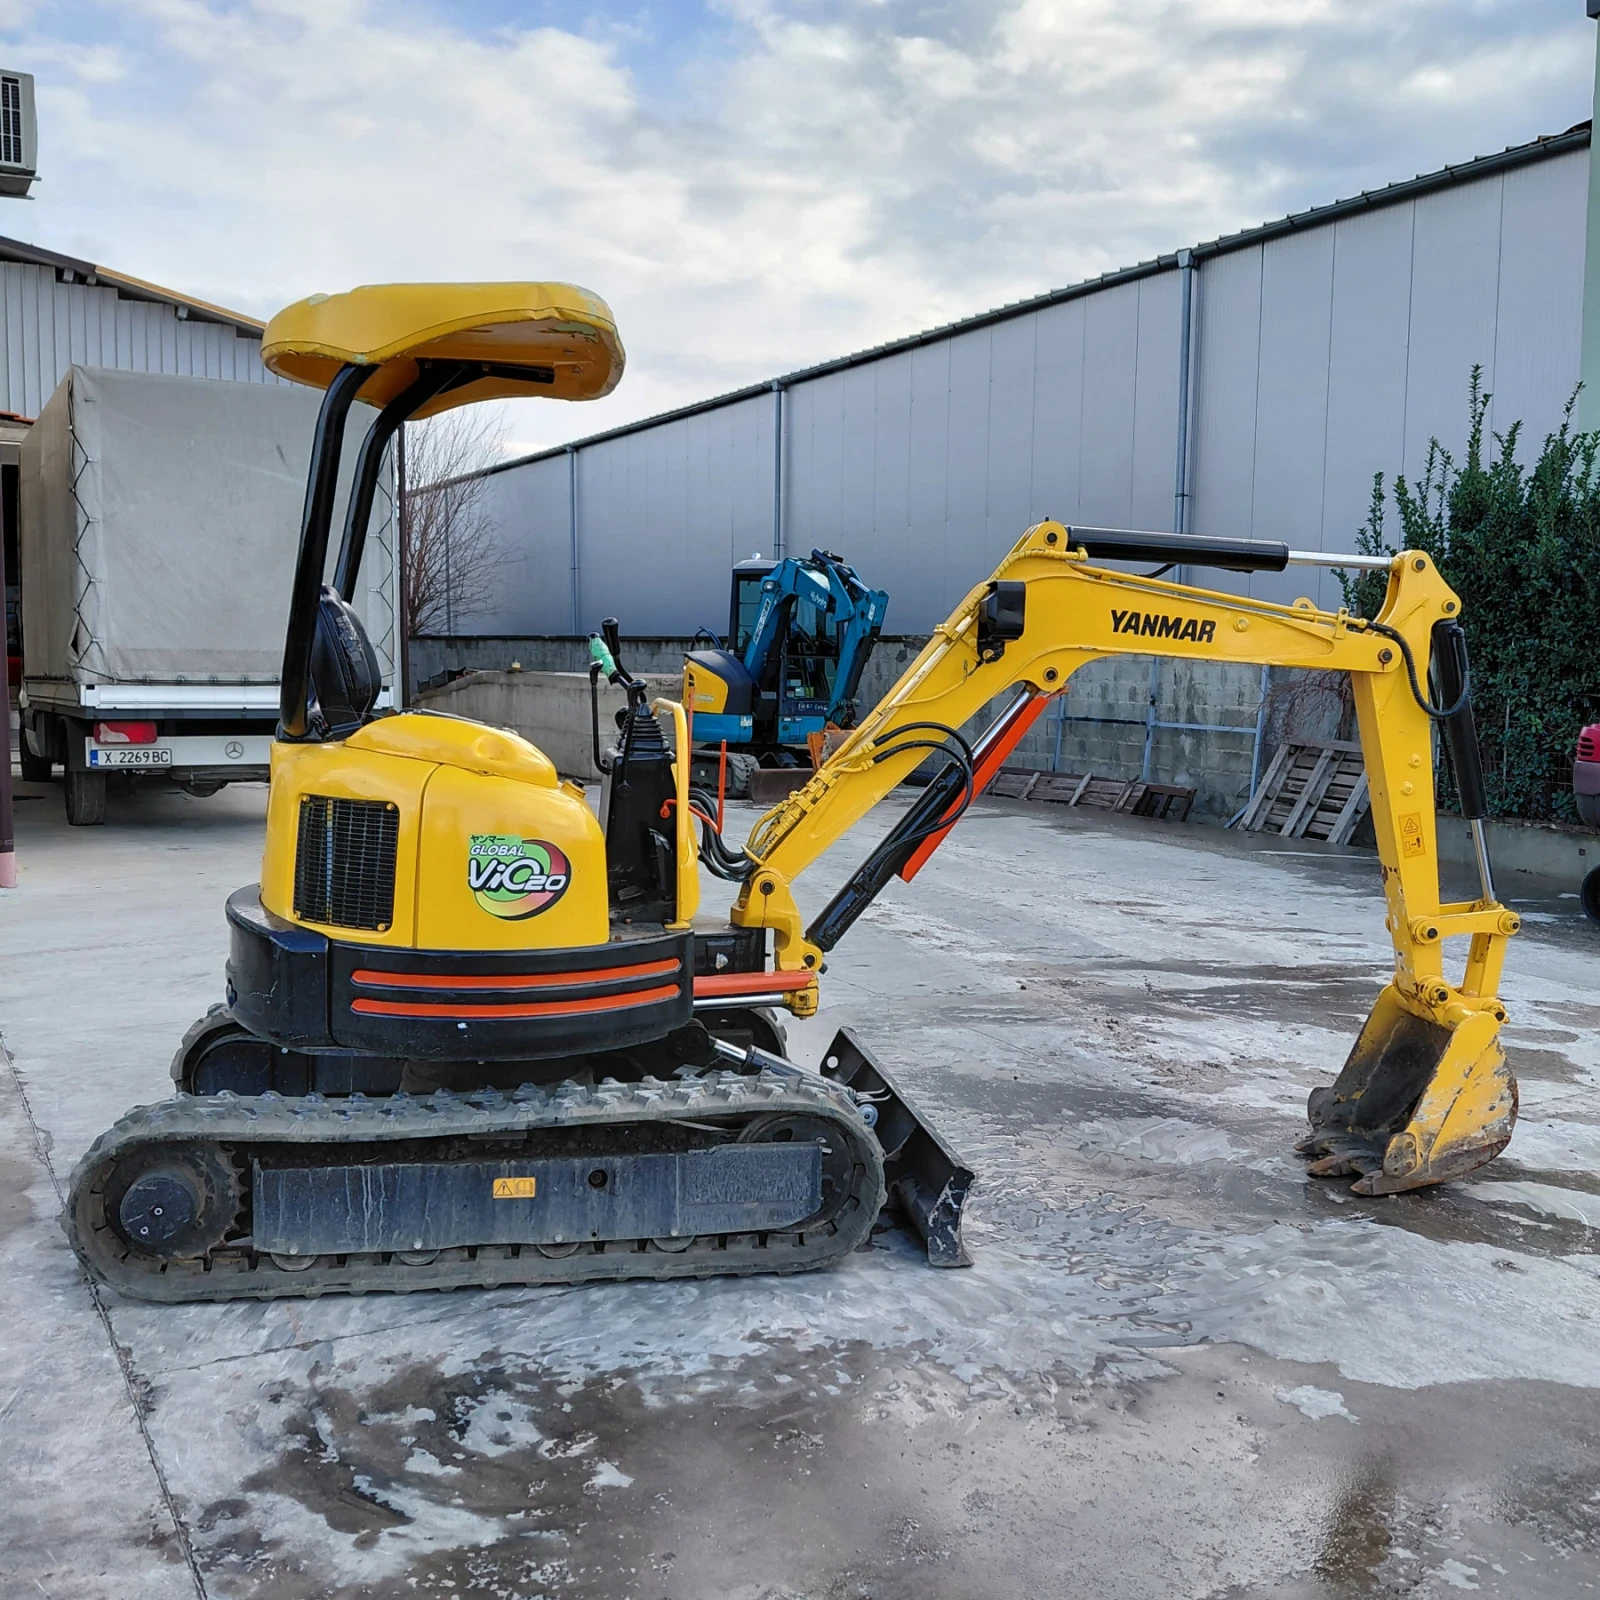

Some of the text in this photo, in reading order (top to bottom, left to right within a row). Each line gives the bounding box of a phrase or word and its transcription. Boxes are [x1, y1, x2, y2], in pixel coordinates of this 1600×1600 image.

[1111, 609, 1216, 643] YANMAR
[470, 835, 506, 844] ヤンマー
[470, 845, 527, 857] GLOBAL
